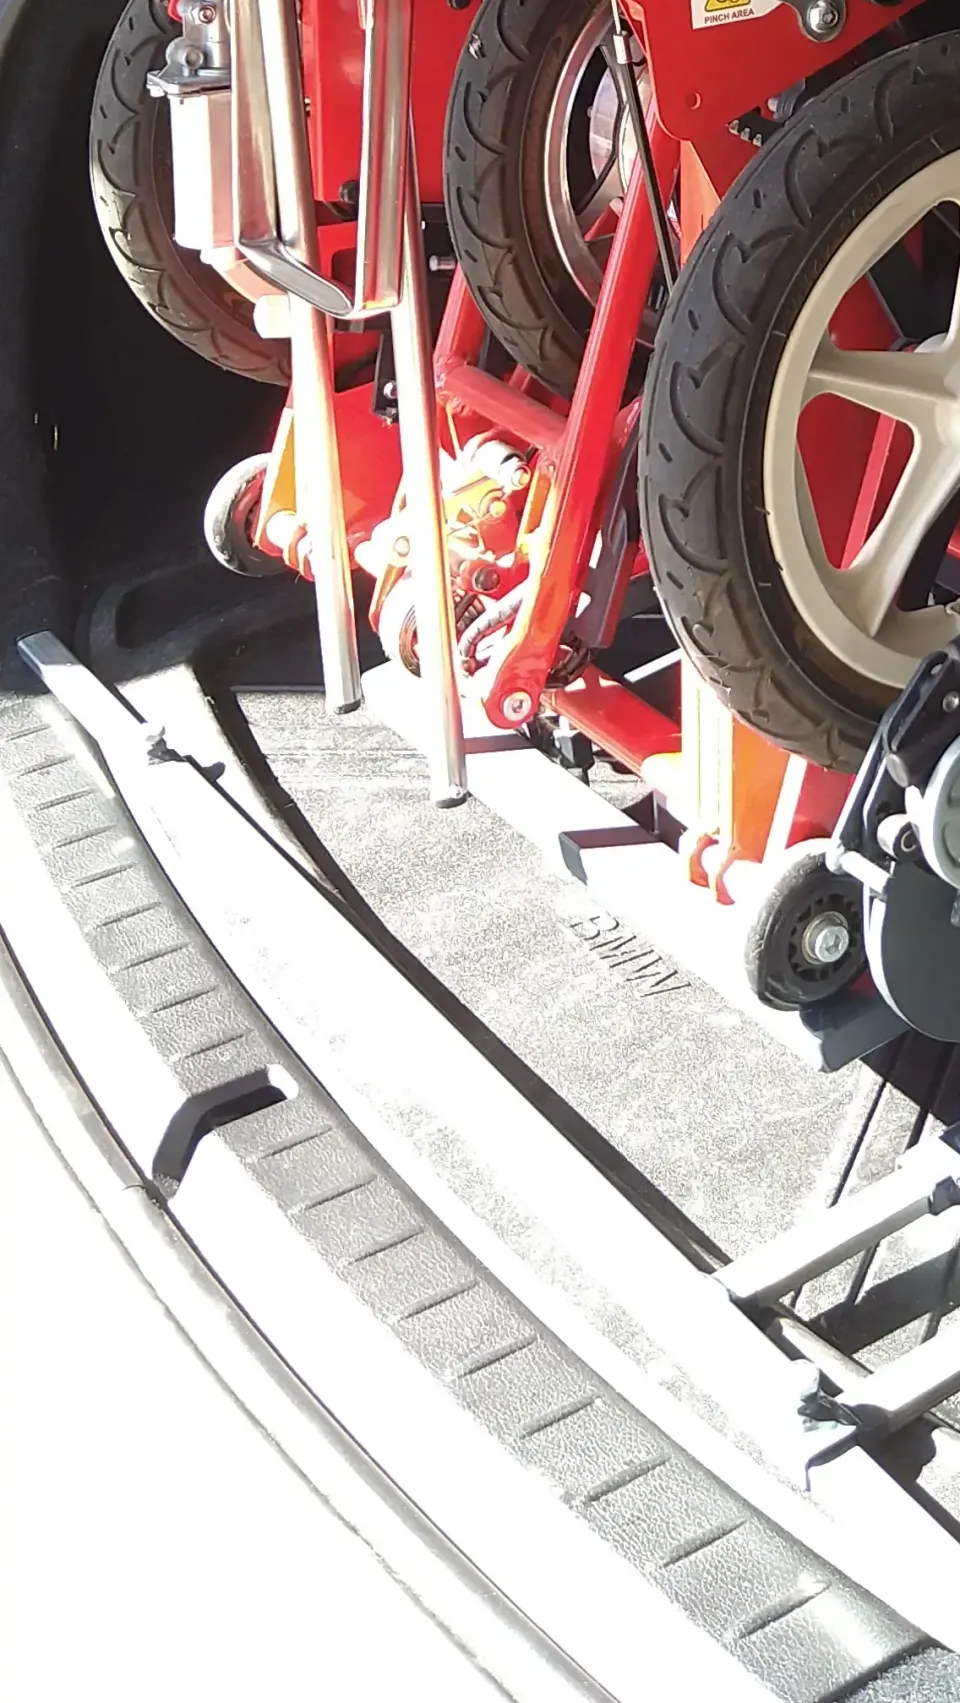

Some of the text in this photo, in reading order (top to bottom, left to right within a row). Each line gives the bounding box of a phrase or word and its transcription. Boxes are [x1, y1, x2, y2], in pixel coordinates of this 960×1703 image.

[704, 7, 755, 25] PINCH AREA
[569, 914, 692, 998] BMW
